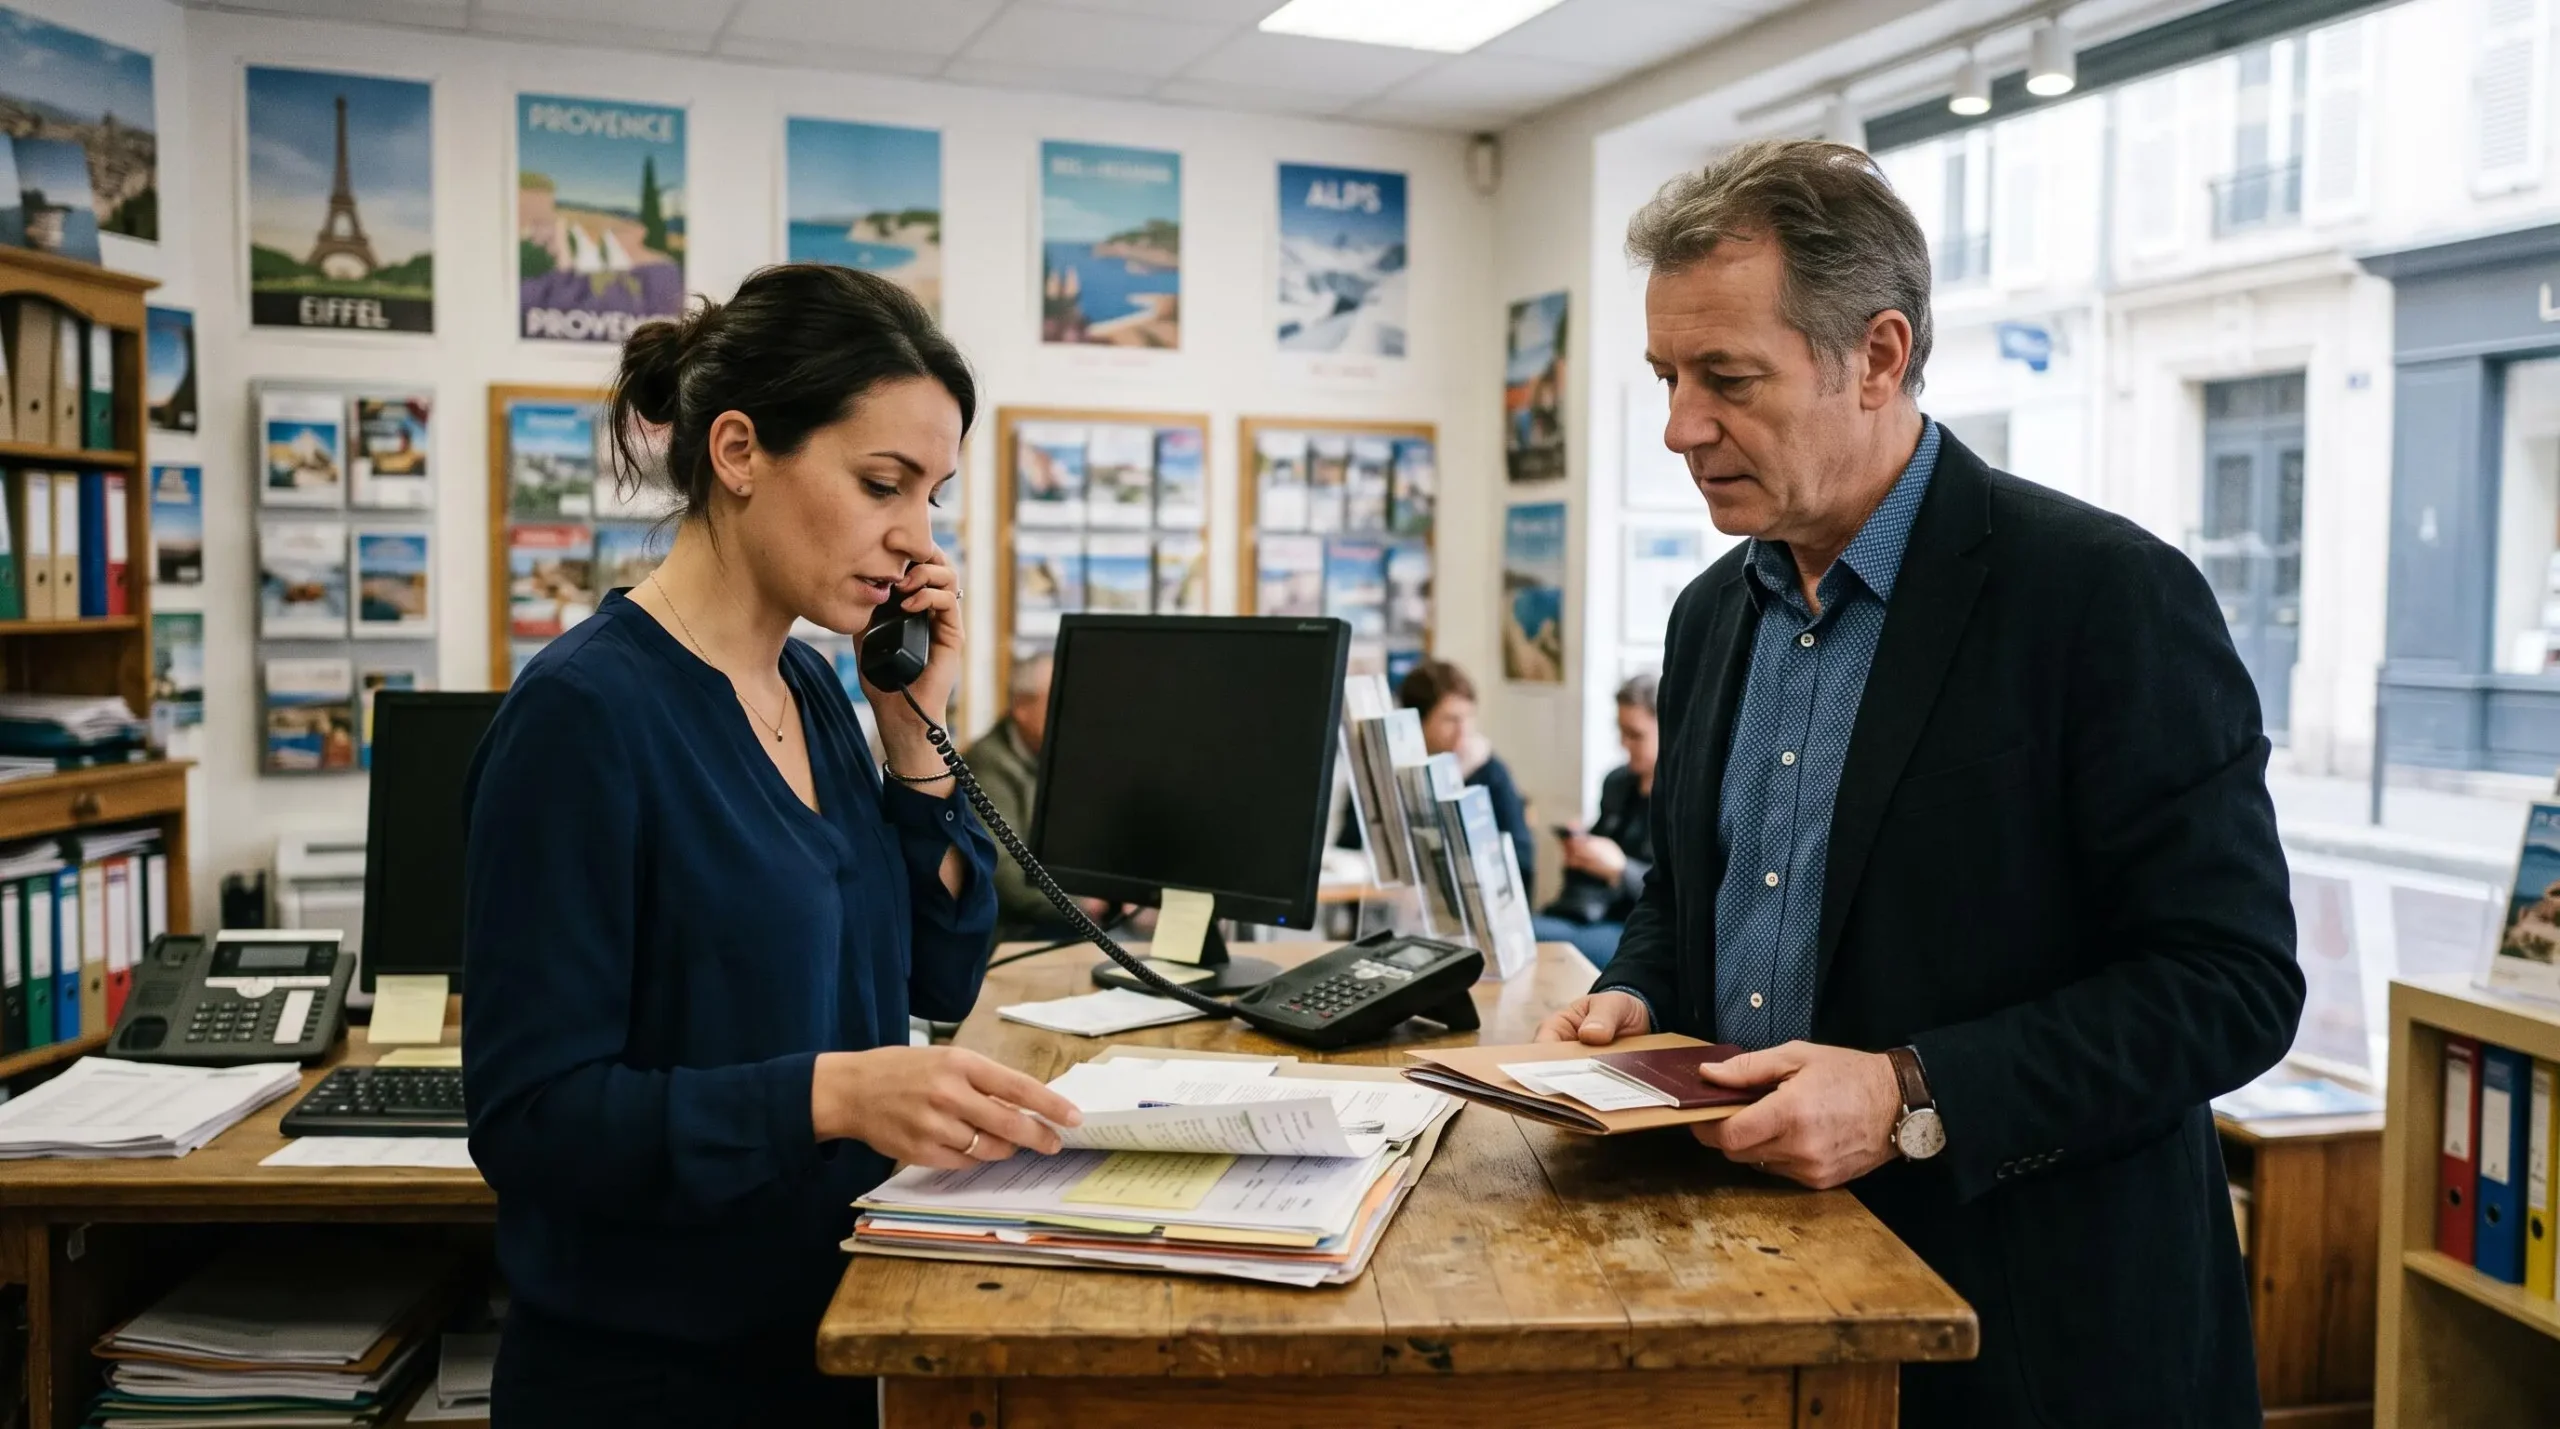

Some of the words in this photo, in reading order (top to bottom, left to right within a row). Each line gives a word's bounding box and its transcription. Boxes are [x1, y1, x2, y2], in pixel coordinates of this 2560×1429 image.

[529, 103, 675, 143] PROVENCE
[1305, 180, 1382, 214] ALPS
[299, 296, 391, 329] EIFFEL
[526, 306, 682, 341] PROVEN
